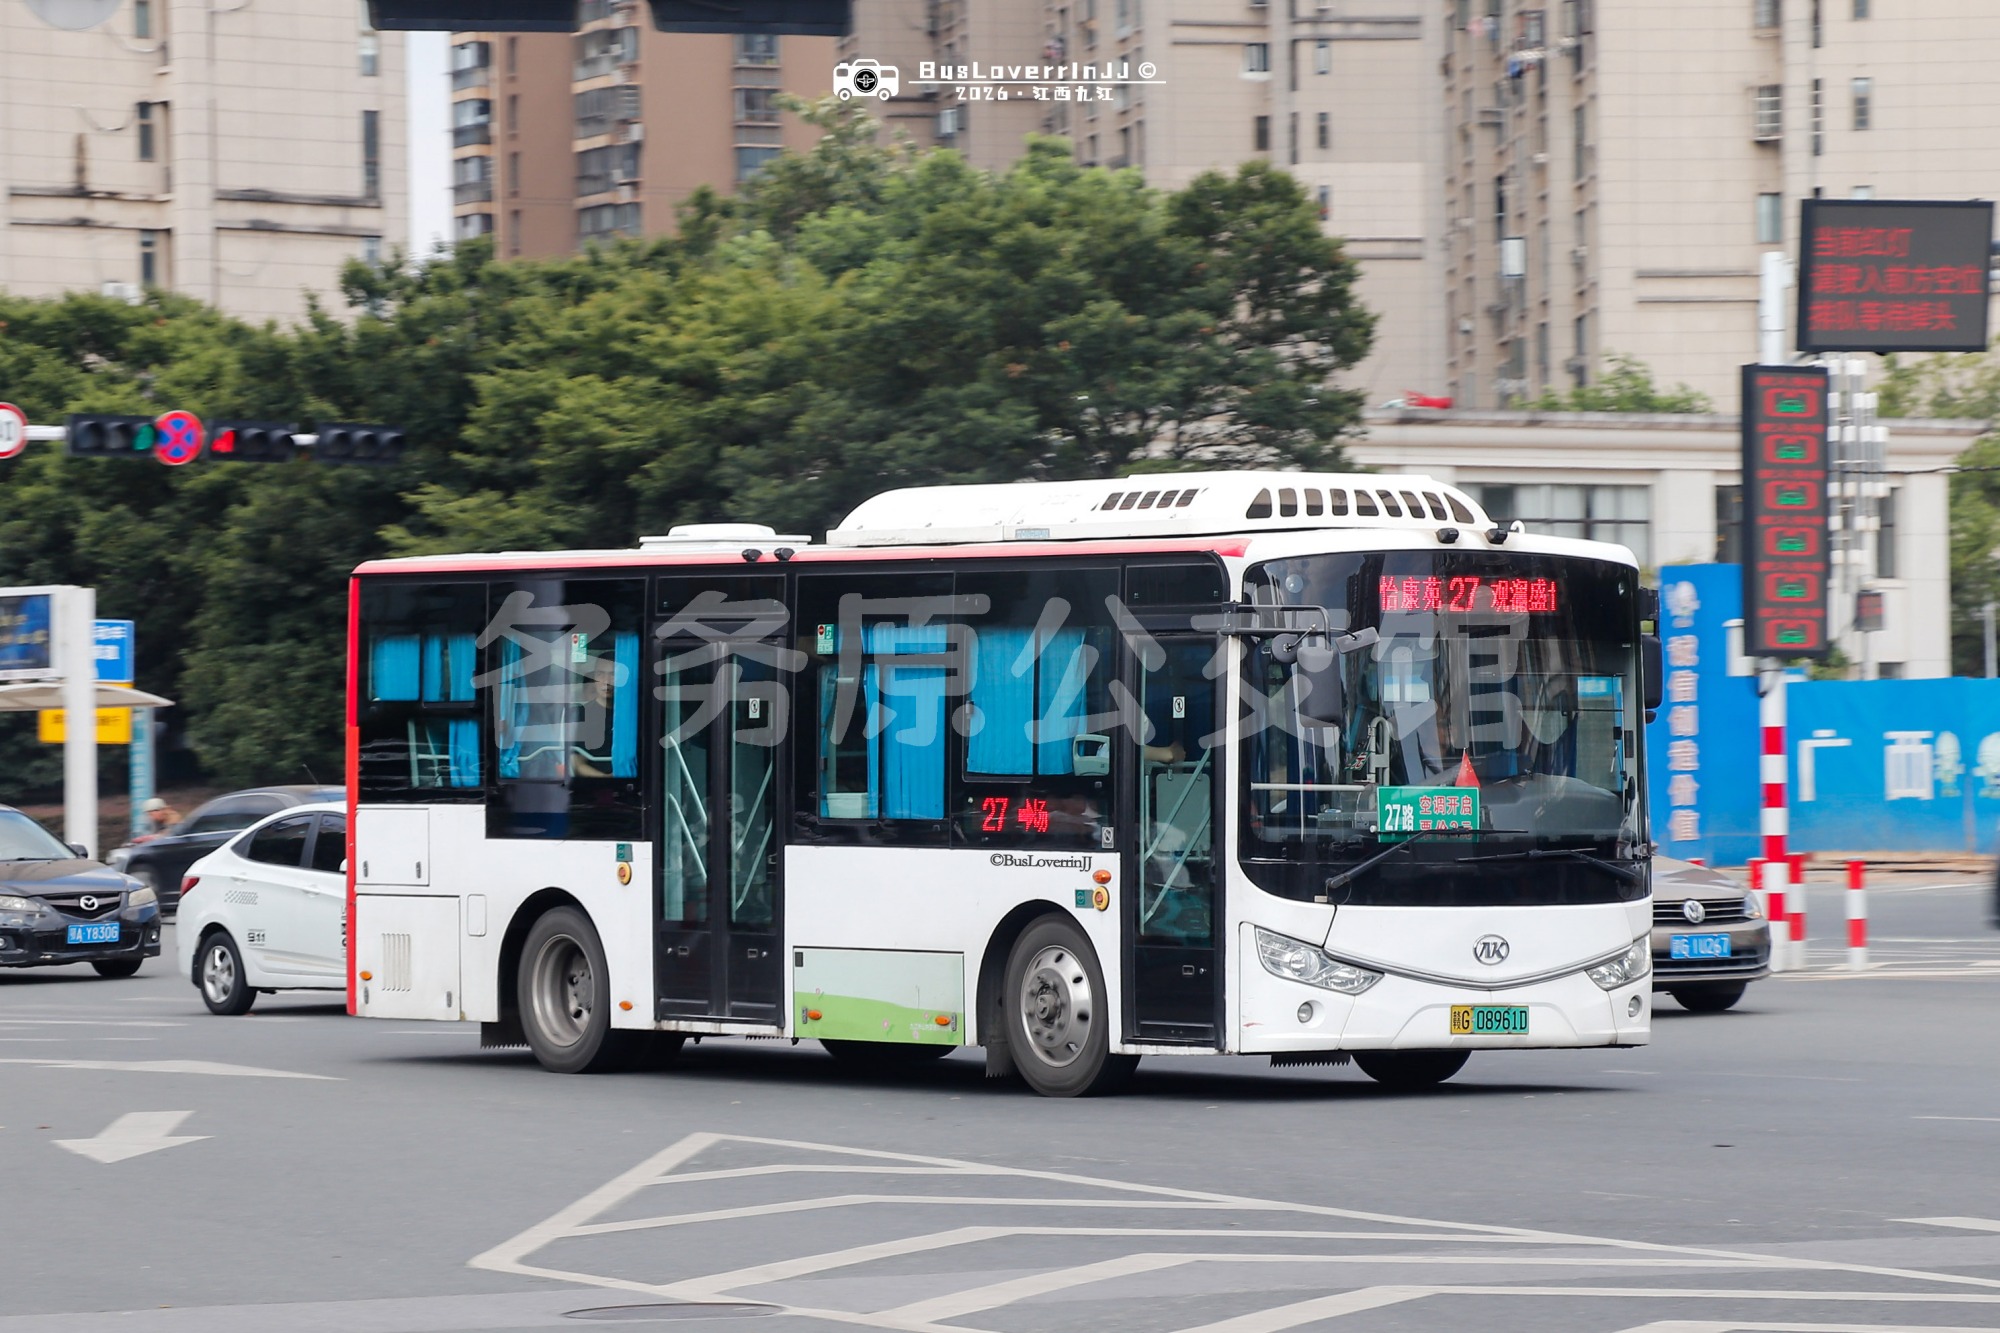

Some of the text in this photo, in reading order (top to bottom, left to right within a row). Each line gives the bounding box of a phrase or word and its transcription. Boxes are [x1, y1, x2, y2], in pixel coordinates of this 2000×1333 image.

[1379, 576, 1443, 611] 怡康苑
[1449, 577, 1480, 612] 27
[982, 797, 1009, 832] 27
[1384, 804, 1414, 837] 27路
[1419, 795, 1473, 816] 空调开启
